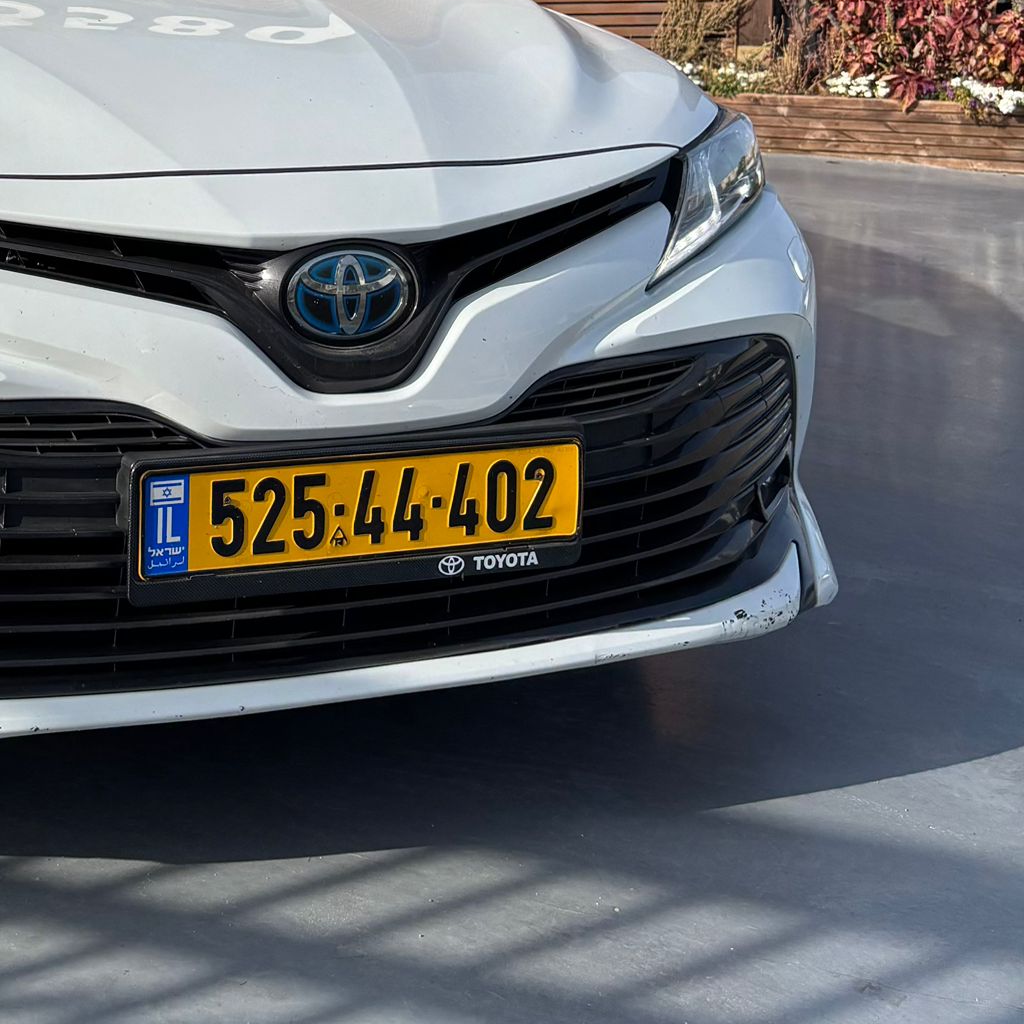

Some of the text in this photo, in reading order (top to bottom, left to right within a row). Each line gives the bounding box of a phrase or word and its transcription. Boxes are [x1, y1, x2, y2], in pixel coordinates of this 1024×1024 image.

[157, 506, 181, 544] IL
[147, 546, 185, 557] ישראל
[473, 551, 539, 571] TOYOTA
